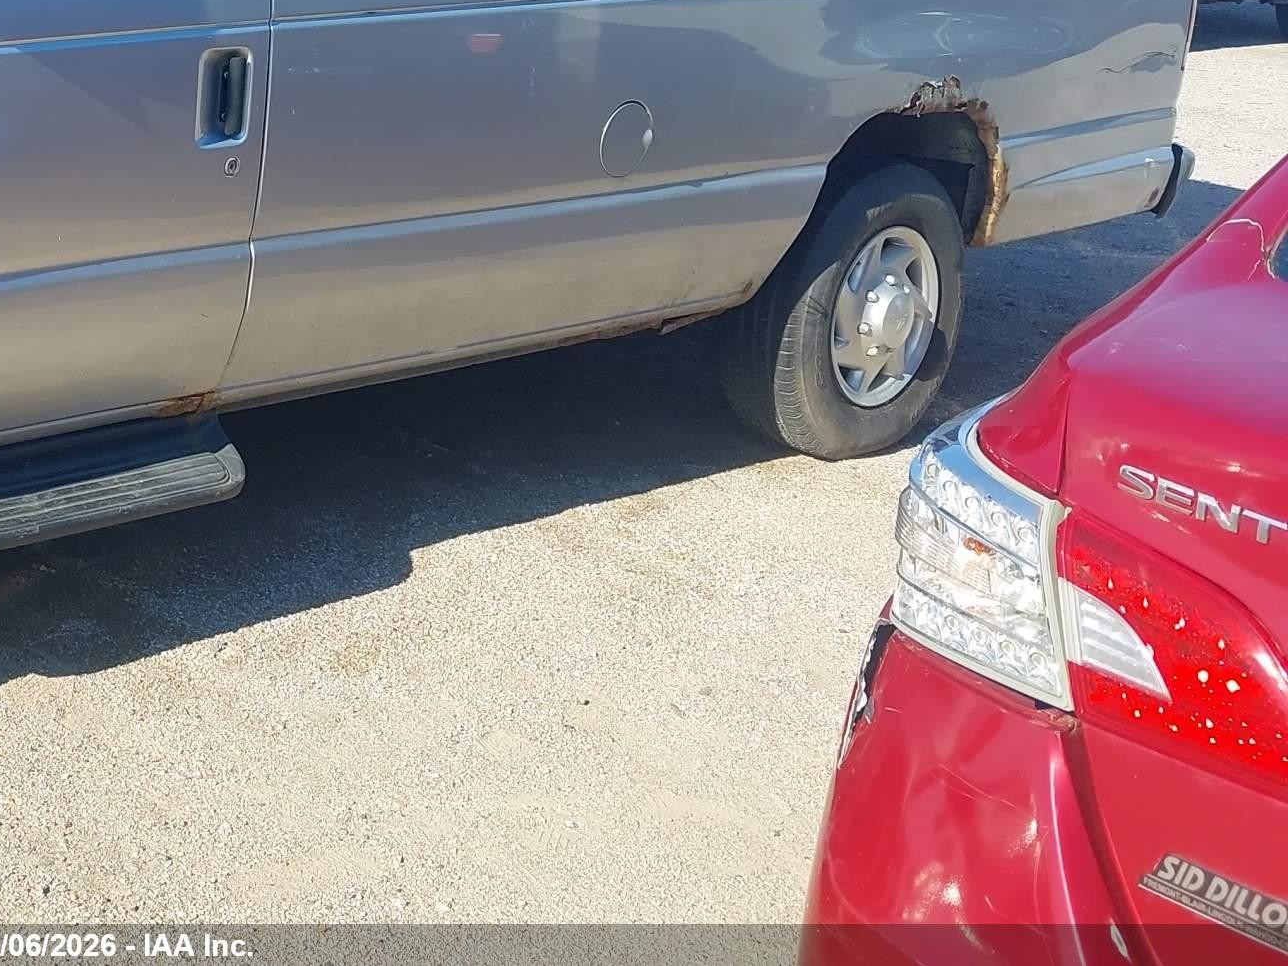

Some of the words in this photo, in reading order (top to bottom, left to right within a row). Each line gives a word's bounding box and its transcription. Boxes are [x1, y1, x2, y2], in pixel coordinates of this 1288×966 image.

[1117, 465, 1288, 544] SENT
[1157, 855, 1205, 891] SID
[1205, 876, 1288, 935] DILLO
